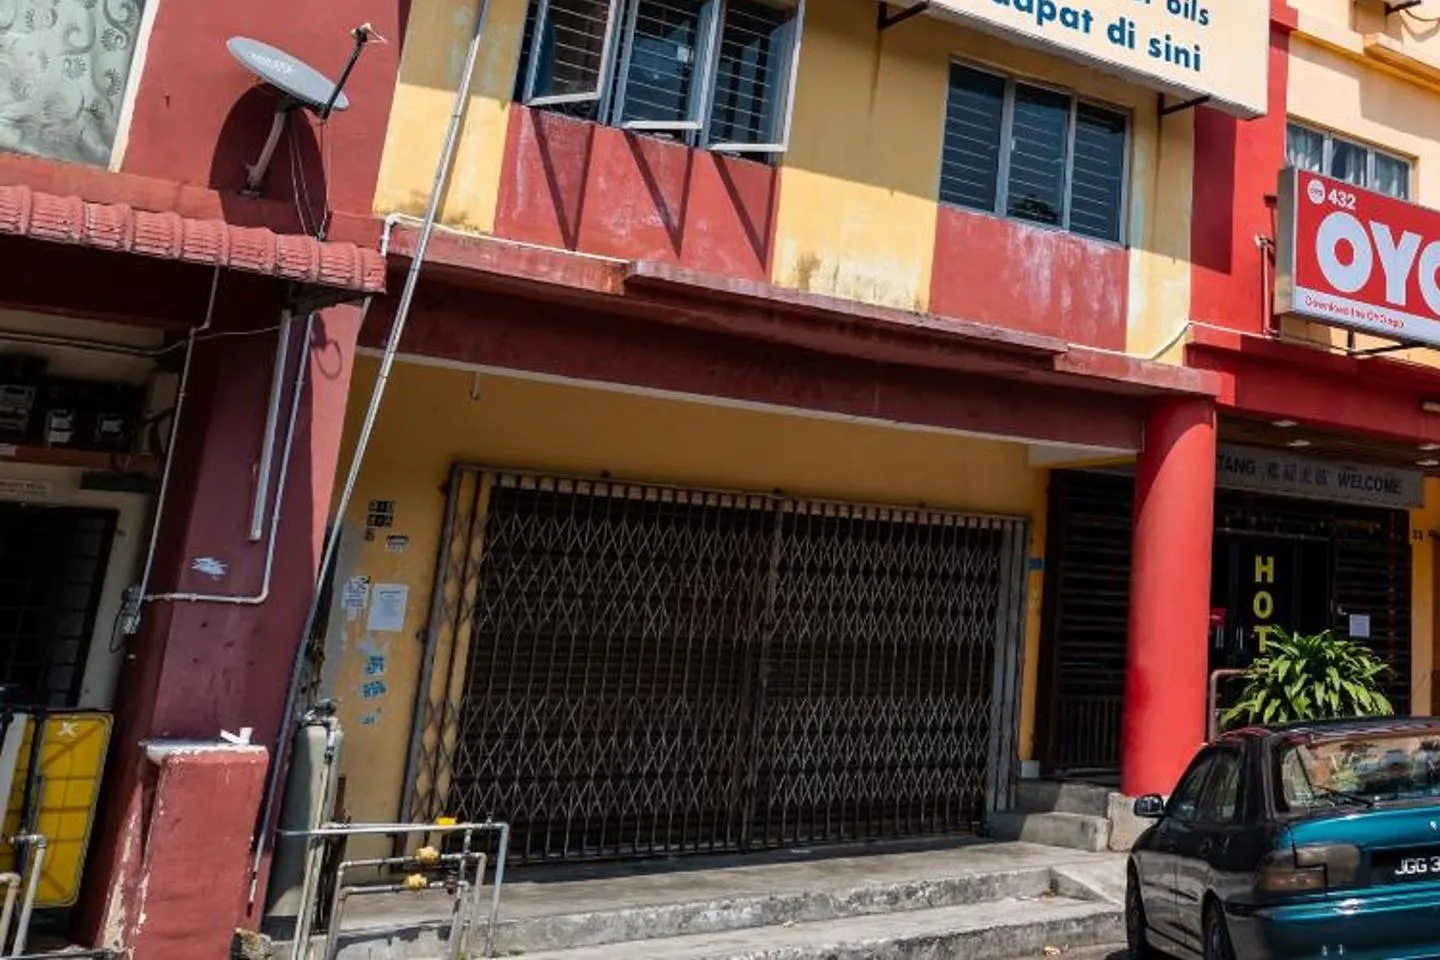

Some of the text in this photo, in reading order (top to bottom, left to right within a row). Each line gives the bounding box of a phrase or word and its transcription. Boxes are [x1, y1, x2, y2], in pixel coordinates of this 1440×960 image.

[1107, 16, 1136, 49] di
[1147, 34, 1202, 72] sini
[1328, 188, 1356, 210] 432
[1337, 470, 1402, 494] WELCOME
[1394, 857, 1428, 876] JGG
